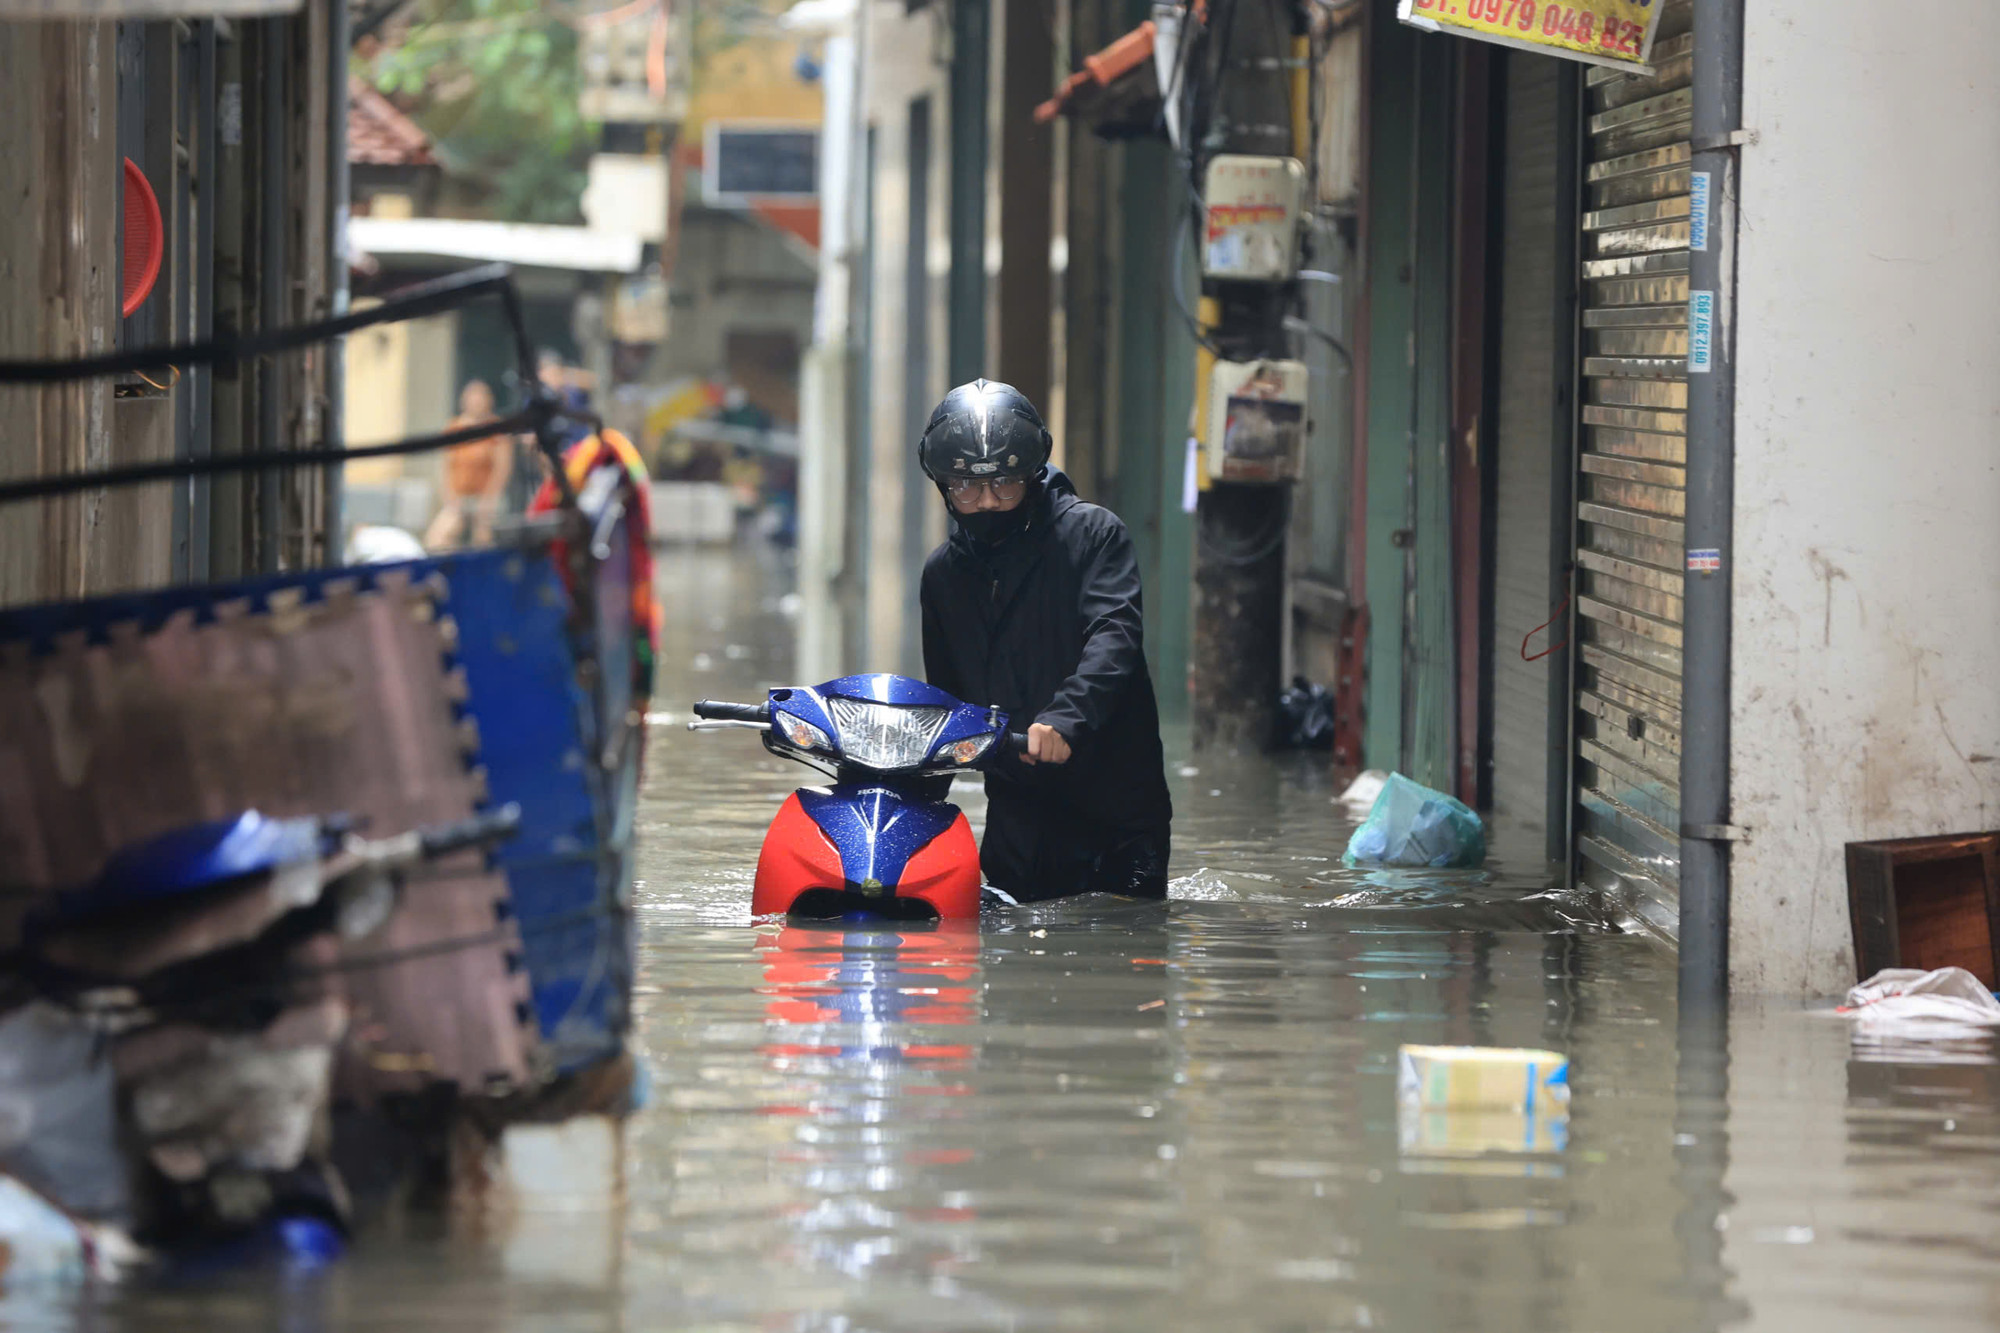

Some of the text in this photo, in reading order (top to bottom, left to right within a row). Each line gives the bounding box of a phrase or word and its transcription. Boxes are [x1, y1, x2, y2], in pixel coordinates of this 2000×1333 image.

[1467, 0, 1536, 31] 0979
[1542, 4, 1595, 44] 048
[857, 788, 902, 800] HONDA
